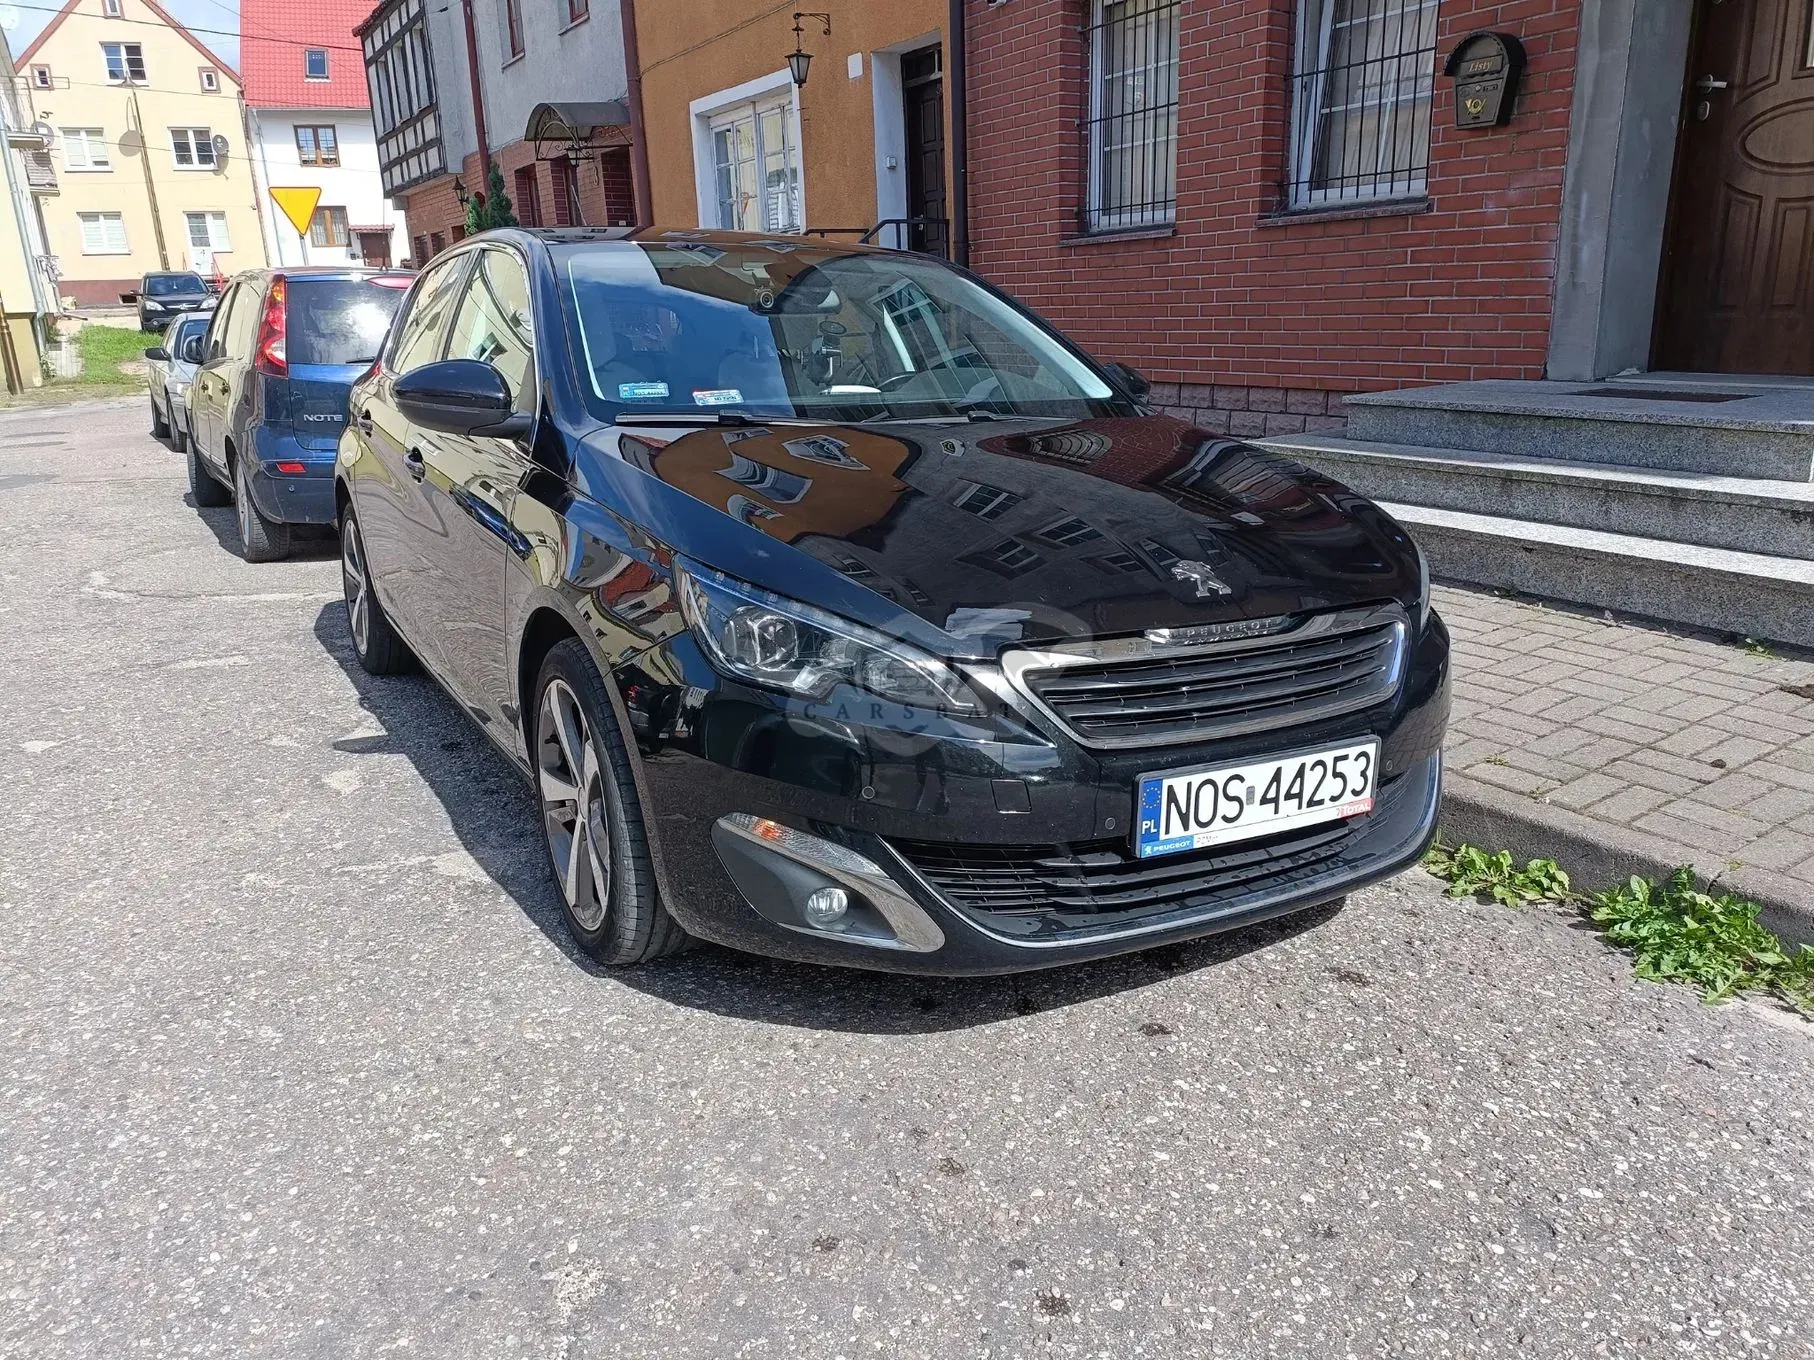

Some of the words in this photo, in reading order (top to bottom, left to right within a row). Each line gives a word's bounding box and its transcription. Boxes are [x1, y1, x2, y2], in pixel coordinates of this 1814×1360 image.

[1469, 60, 1493, 72] Listy
[303, 414, 343, 422] NOTE
[1187, 619, 1271, 638] PEUGEOT
[1164, 773, 1245, 835] NOS
[1259, 750, 1372, 815] 44253
[1343, 802, 1371, 816] TOTAL
[1141, 819, 1158, 835] PL
[1153, 840, 1192, 852] PEUGEOT
